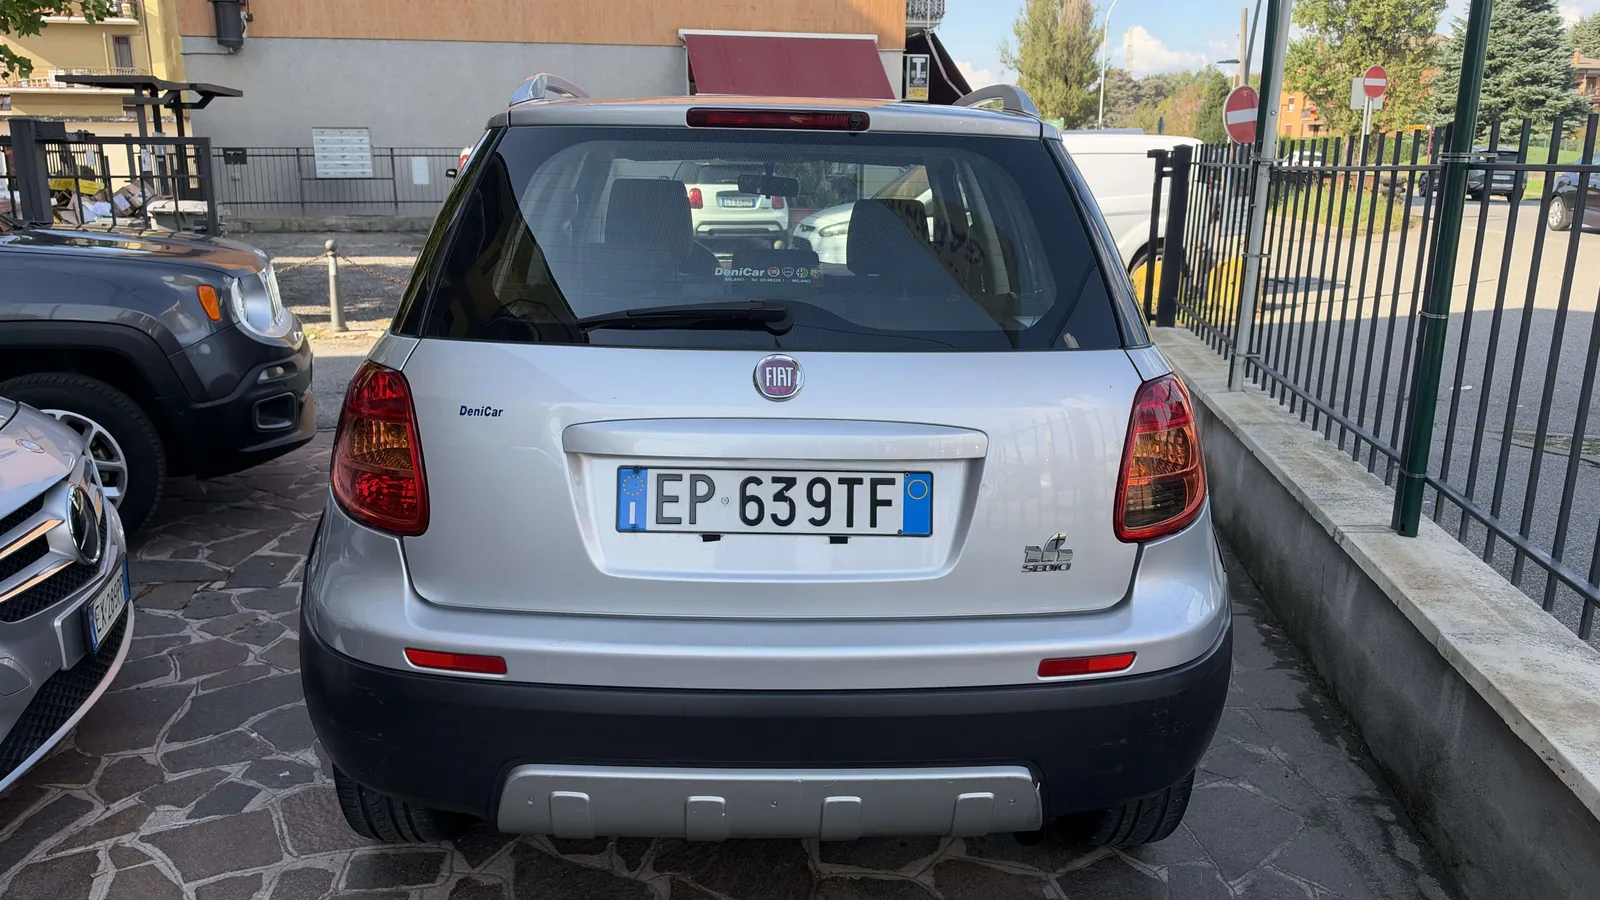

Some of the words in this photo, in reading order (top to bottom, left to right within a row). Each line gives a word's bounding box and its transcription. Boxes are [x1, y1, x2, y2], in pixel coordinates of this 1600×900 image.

[912, 57, 926, 79] T
[714, 267, 765, 277] DeniCar
[765, 366, 794, 387] FIAT
[459, 405, 504, 417] DeniCar
[655, 473, 716, 525] EP
[739, 476, 897, 528] 639TF
[1021, 563, 1072, 572] SEDICI
